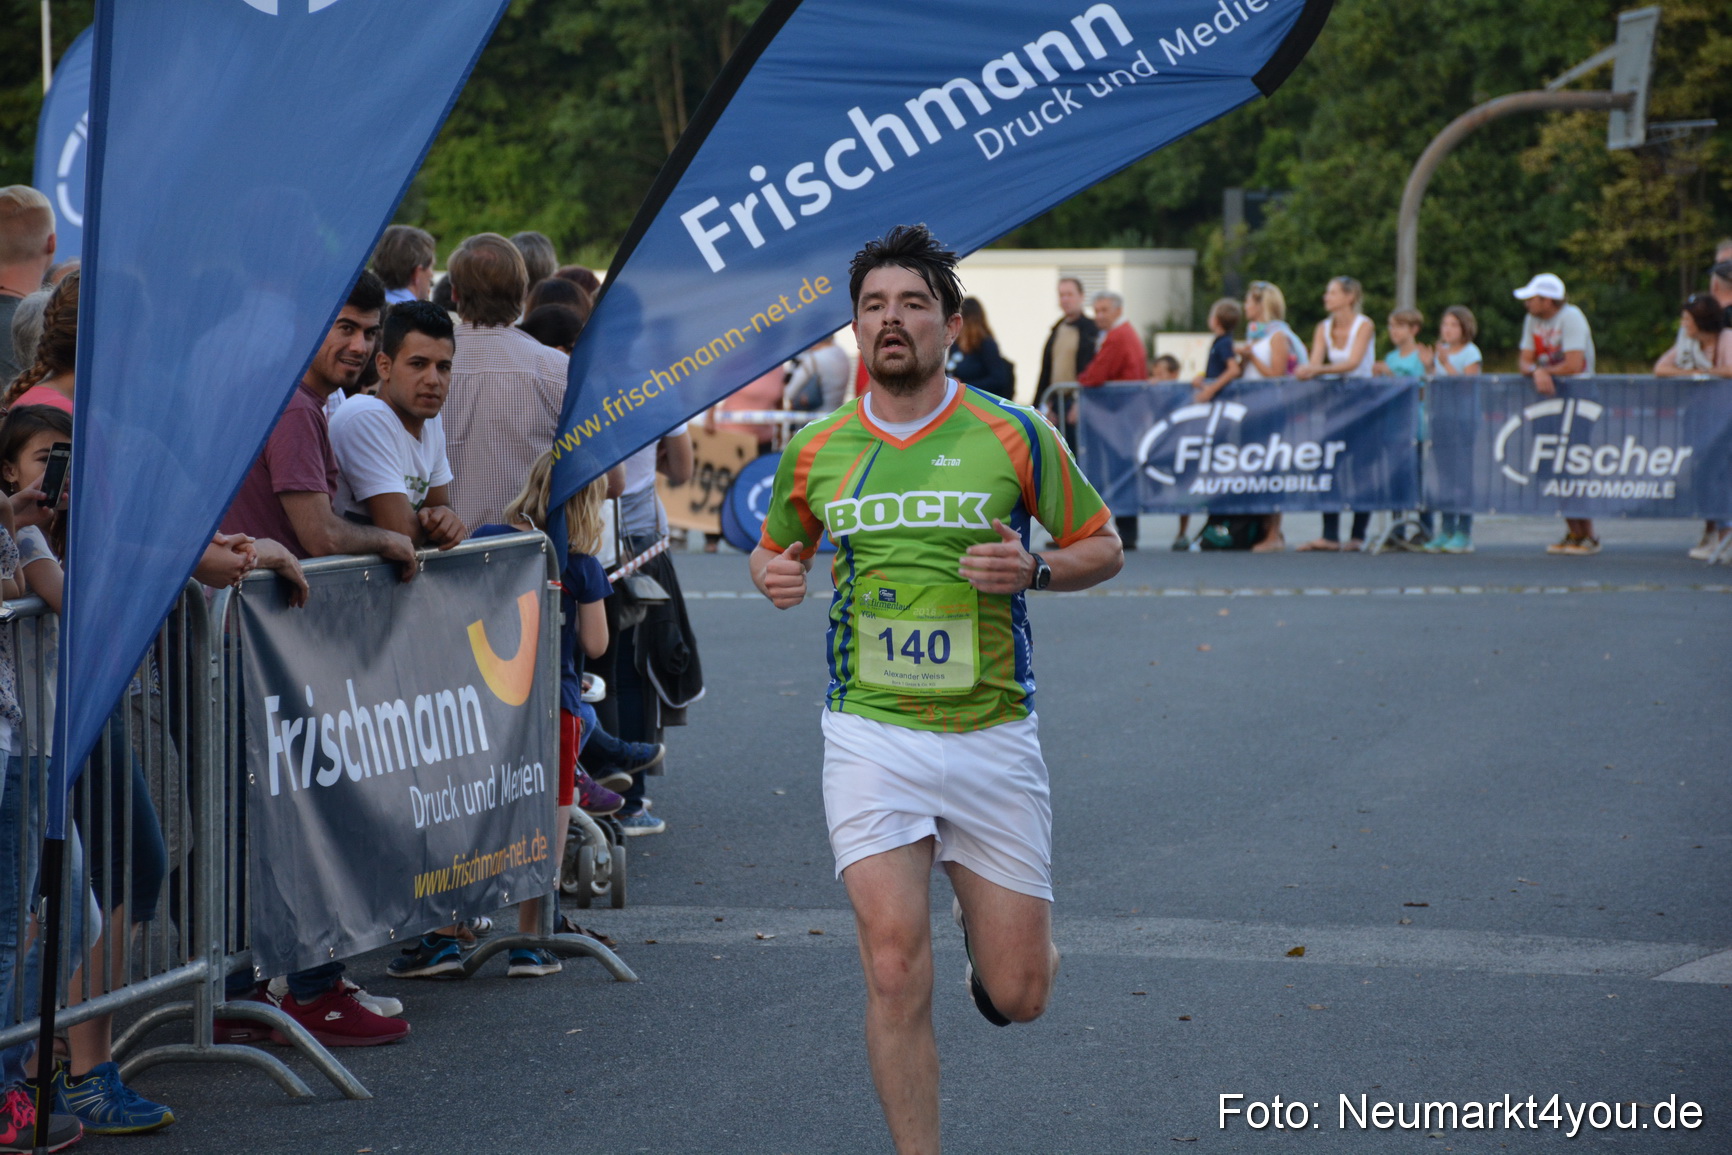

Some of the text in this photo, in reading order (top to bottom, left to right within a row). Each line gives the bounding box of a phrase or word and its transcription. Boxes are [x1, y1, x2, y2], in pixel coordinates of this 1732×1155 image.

[973, 0, 1278, 161] Druck und Medie
[680, 3, 1133, 273] Frischmann
[550, 275, 832, 466] www.frischmann-net.de
[1174, 432, 1346, 474] Fischer
[1529, 434, 1693, 476] Fischer
[1189, 474, 1333, 495] AUTOMOBILE
[1543, 479, 1676, 499] AUTOMOBILE
[825, 490, 992, 538] BOCK
[878, 627, 951, 665] 140
[884, 669, 945, 681] Alexander Weiss
[264, 679, 489, 797] Frischmann
[409, 755, 545, 829] Druck und Medien
[414, 828, 548, 899] www.frischmann-net.de
